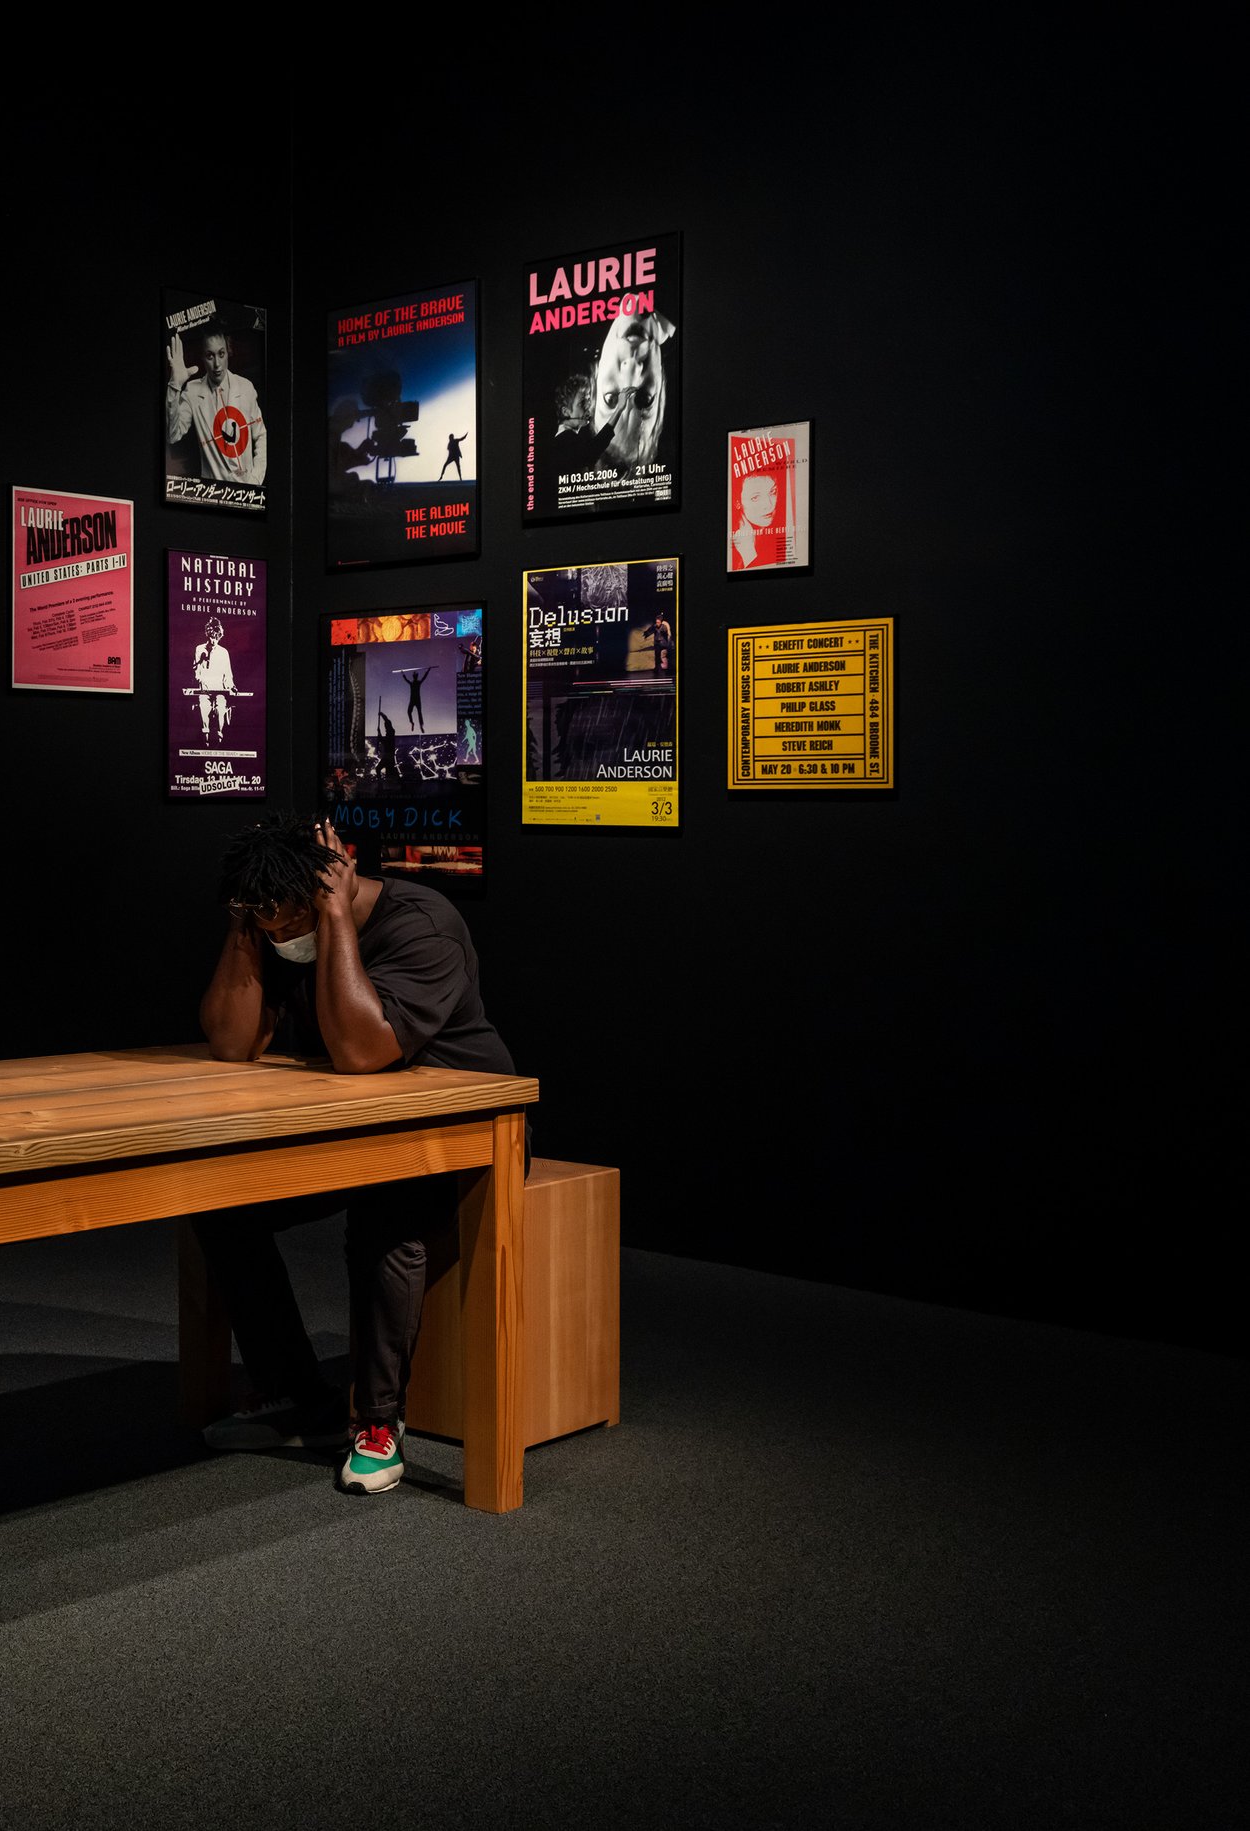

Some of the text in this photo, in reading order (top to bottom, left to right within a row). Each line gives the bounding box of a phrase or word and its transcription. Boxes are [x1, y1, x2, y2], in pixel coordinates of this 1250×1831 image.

[529, 247, 657, 307] LAURIE
[337, 294, 464, 334] HOME OF THE BRAVE
[529, 289, 655, 335] ANDERSON
[338, 312, 464, 347] A FILM BY LAURIE ANDERSON
[526, 445, 535, 462] the
[734, 432, 775, 461] LAURIE
[733, 441, 791, 478] ANDERSON
[526, 474, 535, 493] end
[558, 463, 666, 486] Mi 03.05.2006 21 Uhr
[576, 482, 610, 492] Hochschule
[611, 480, 620, 489] für
[621, 477, 654, 488] Gestaltung
[405, 502, 470, 523] THE ALBUM
[526, 494, 535, 511] the
[21, 506, 65, 531] LAURIE
[26, 510, 117, 565] ANDERSON
[405, 520, 467, 540] THE MOVIE
[22, 555, 126, 588] UNITED STATES: PARTS I-IV
[181, 556, 256, 579] NATURAL
[184, 577, 253, 597] HISTORY
[181, 603, 257, 617] LAURIE ANDERSON
[528, 605, 629, 629] Delusion
[530, 627, 562, 648] 妄想
[773, 636, 845, 652] BENEFIT CONCERT
[772, 660, 846, 675] LAURIE ANDERSON
[776, 680, 840, 694] ROBERT ASHLEY
[741, 641, 751, 778] CONTEMPORARY MUSIC SERIES
[780, 700, 836, 713] PHILIP GLASS
[869, 634, 880, 776] THE KITCHEN 484 BROOME ST.
[774, 719, 842, 733] MEREDITH MONK
[624, 748, 673, 762] LAURIE
[782, 739, 833, 752] STEVE REICH
[204, 760, 234, 775] SAGA
[596, 763, 673, 779] ANDERSON
[761, 762, 855, 775] MAY 20 6:30 & 10 PM
[201, 780, 237, 793] UDSOLGT
[251, 775, 262, 785] 20
[334, 804, 463, 831] MOBY DICK
[651, 801, 673, 816] 3/3
